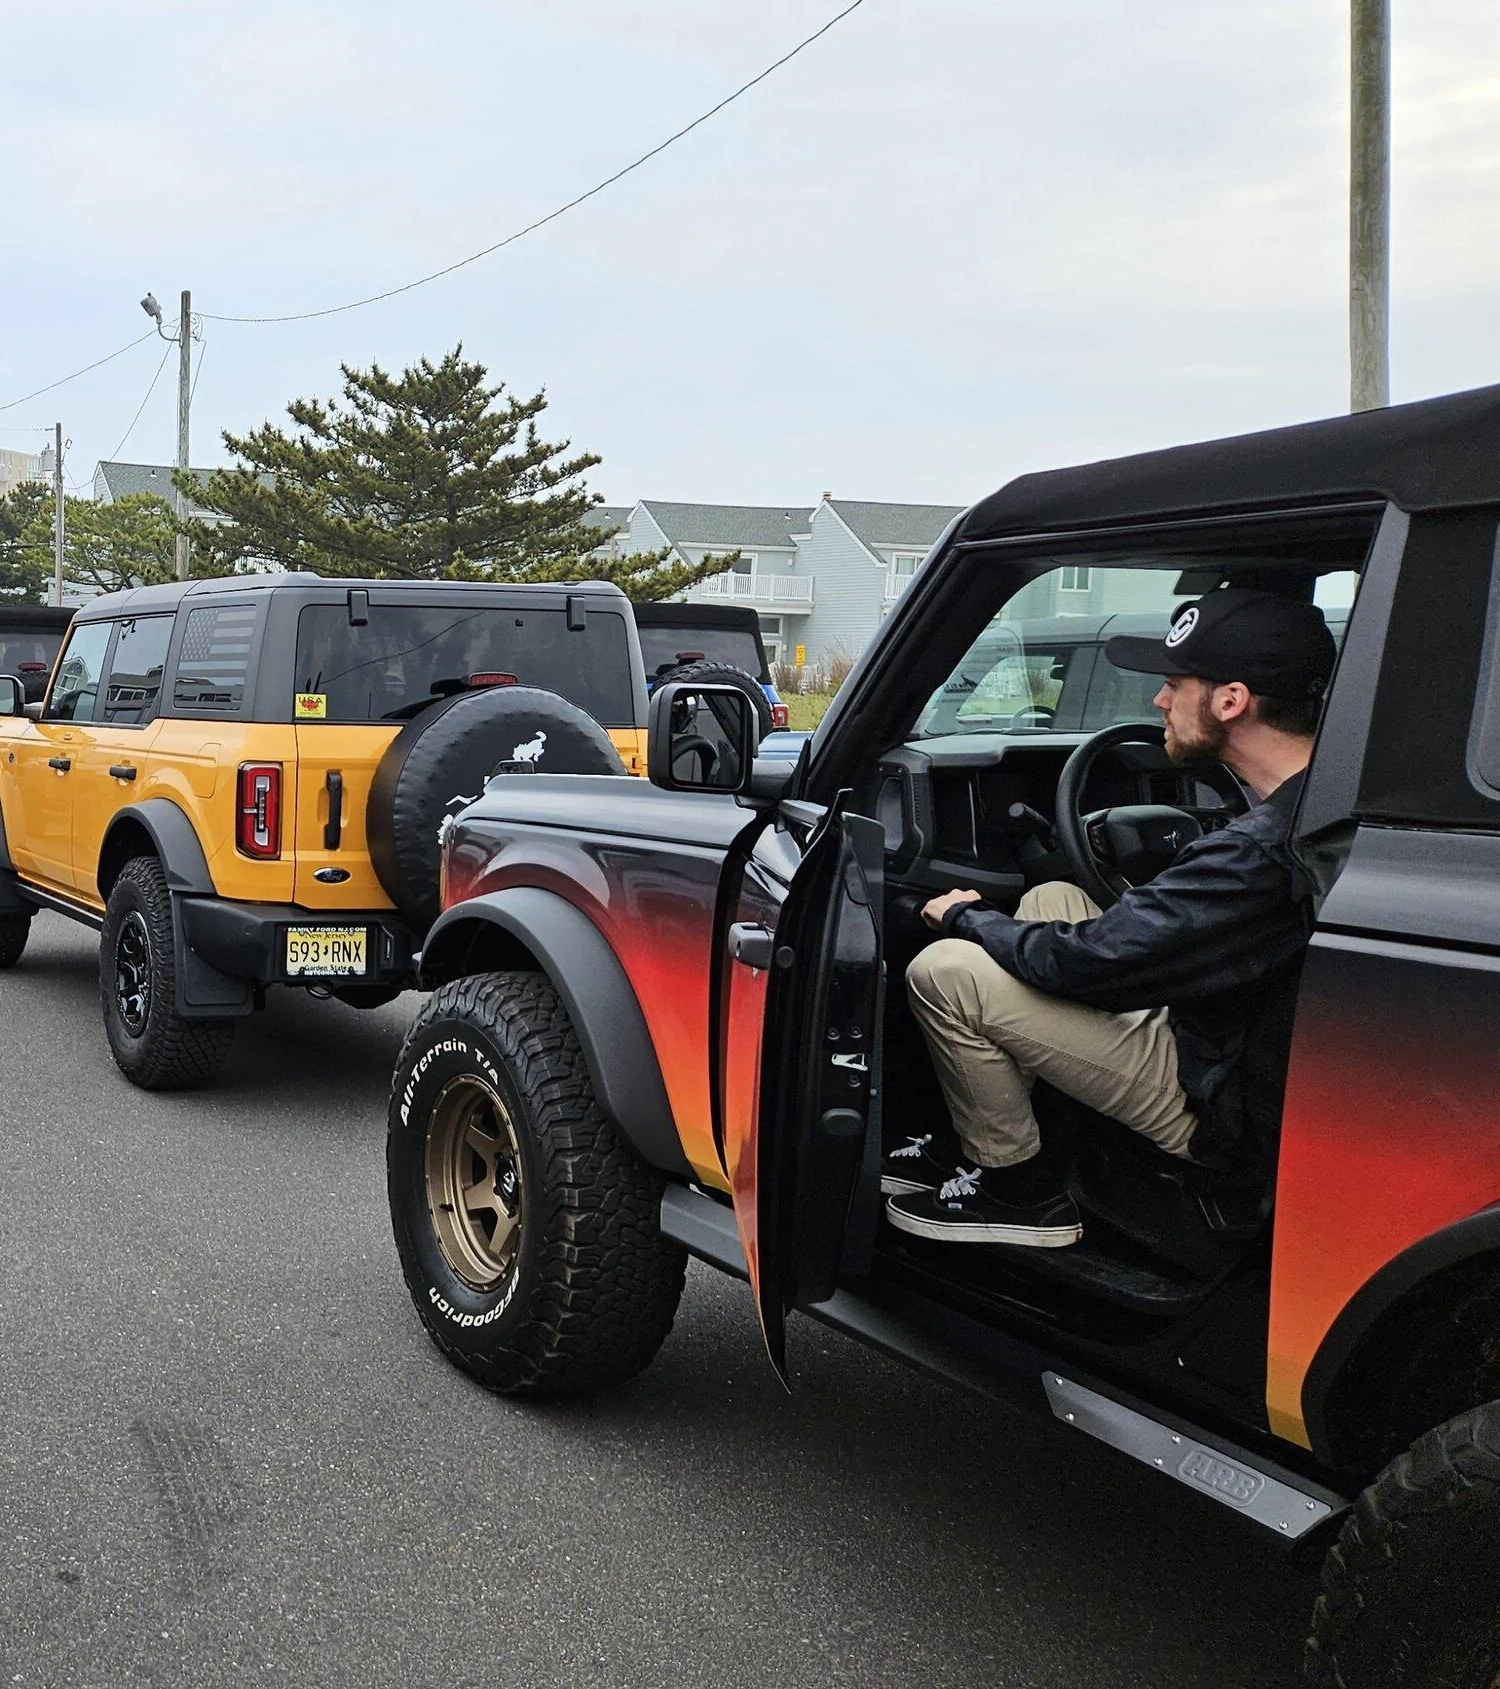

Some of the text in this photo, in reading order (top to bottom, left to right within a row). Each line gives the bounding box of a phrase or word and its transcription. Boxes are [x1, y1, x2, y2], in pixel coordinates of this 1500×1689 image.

[298, 696, 323, 704] USA
[289, 941, 362, 963] S93 RNX
[305, 930, 347, 940] New Jersey
[400, 1037, 468, 1127] All-Terrain
[428, 1266, 520, 1328] BFGoodrich
[1183, 1454, 1256, 1500] ARB
